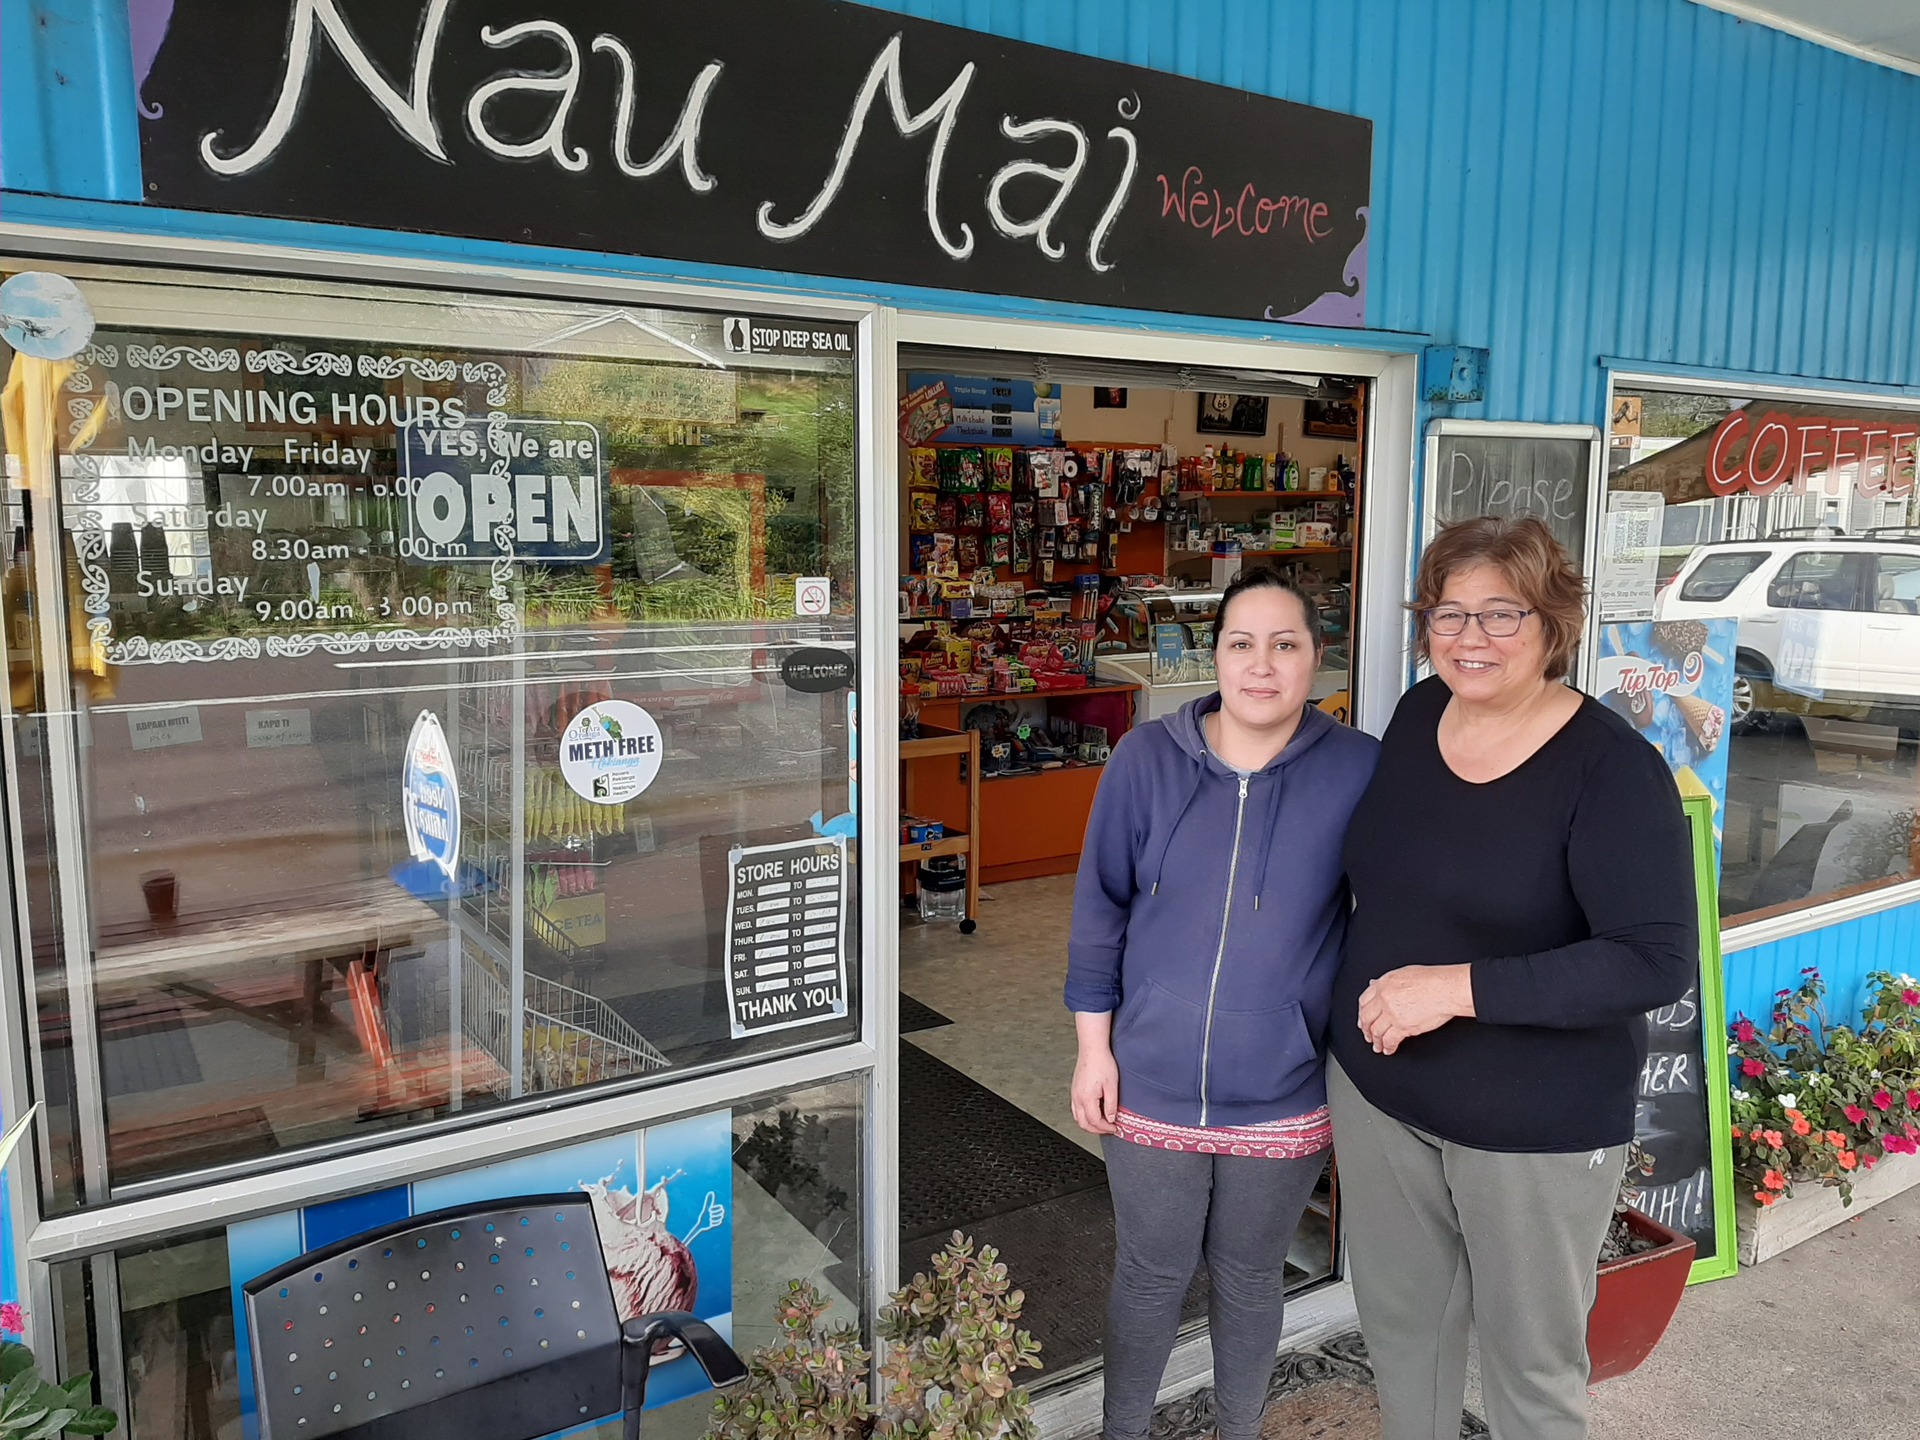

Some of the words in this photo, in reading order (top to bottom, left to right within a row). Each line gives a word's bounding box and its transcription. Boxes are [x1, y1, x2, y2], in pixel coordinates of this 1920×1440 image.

[200, 0, 725, 192] Nau
[757, 31, 1141, 272] Mai
[752, 328, 780, 347] STOP
[783, 329, 810, 348] DEEP
[812, 331, 833, 350] SEA
[834, 333, 852, 351] OIL
[122, 386, 317, 425] OPENING
[332, 392, 466, 429] HOURS
[128, 436, 253, 472] Monday
[285, 439, 371, 474] Friday
[500, 431, 539, 458] We
[549, 439, 593, 459] are
[1707, 411, 1918, 498] COFFEE
[248, 476, 346, 498] 7.00am
[1449, 450, 1577, 521] Please
[131, 501, 267, 534] Saturday
[416, 471, 598, 544] OPEN
[251, 538, 350, 561] 8.30am
[136, 568, 249, 603] Sunday
[255, 599, 353, 622] 9.00am
[1618, 667, 1648, 694] Tip
[1647, 665, 1680, 693] Top
[568, 740, 614, 762] METH
[618, 735, 655, 757] FREE
[737, 861, 784, 885] STORE
[790, 854, 840, 876] HOURS
[793, 881, 803, 890] TO
[792, 897, 802, 906] TO
[792, 913, 802, 922] TO
[792, 929, 802, 937] TO
[792, 945, 802, 953] TO
[792, 962, 803, 970] TO
[793, 978, 803, 987] TO
[737, 992, 798, 1021] THANK
